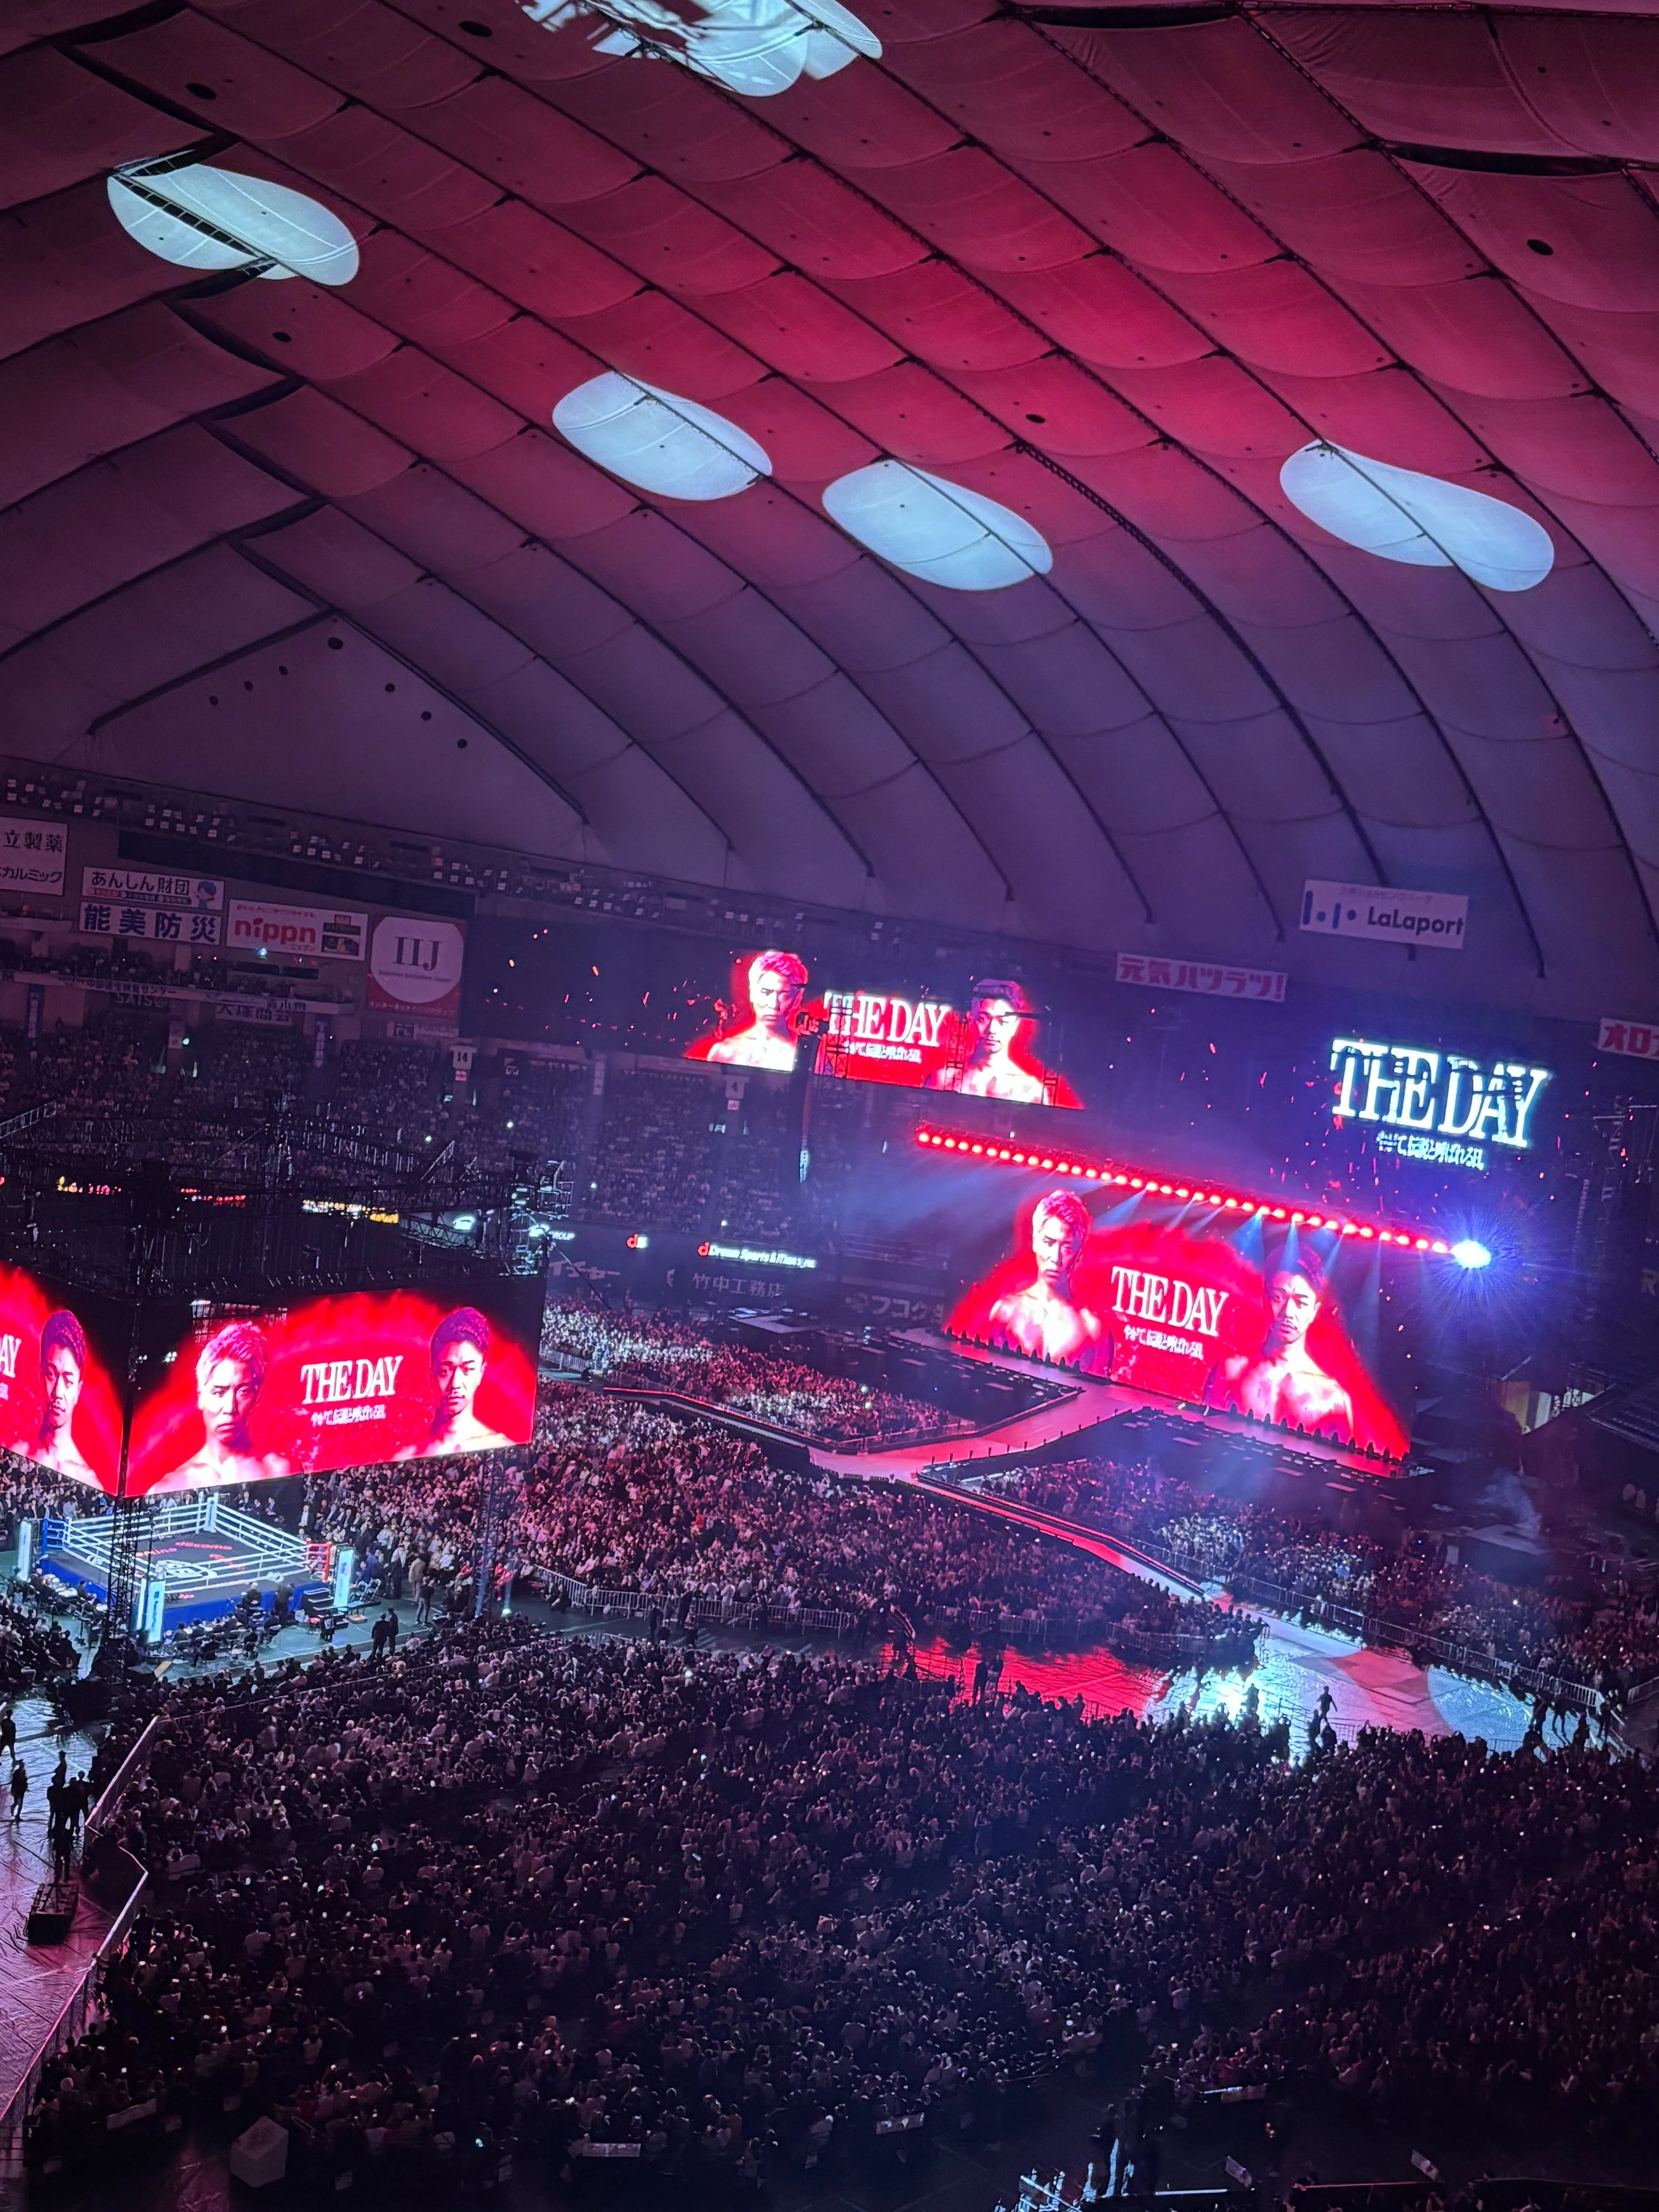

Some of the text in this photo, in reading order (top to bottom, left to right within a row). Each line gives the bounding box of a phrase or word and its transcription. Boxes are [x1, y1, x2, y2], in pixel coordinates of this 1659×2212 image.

[0, 866, 62, 883] カルミック
[92, 872, 189, 895] あんしん財団
[84, 904, 216, 943] 能美防災
[234, 917, 316, 945] nippn
[1368, 906, 1464, 936] LaLaport
[392, 936, 443, 971] IIJ
[823, 991, 951, 1047] THE DAY
[458, 1052, 467, 1062] 14
[731, 1081, 738, 1092] 4
[1330, 1039, 1548, 1148] THE DAY
[693, 1273, 785, 1298] 竹中工務店
[1111, 1266, 1230, 1337] THE DAY
[301, 1355, 404, 1405] THE DAY
